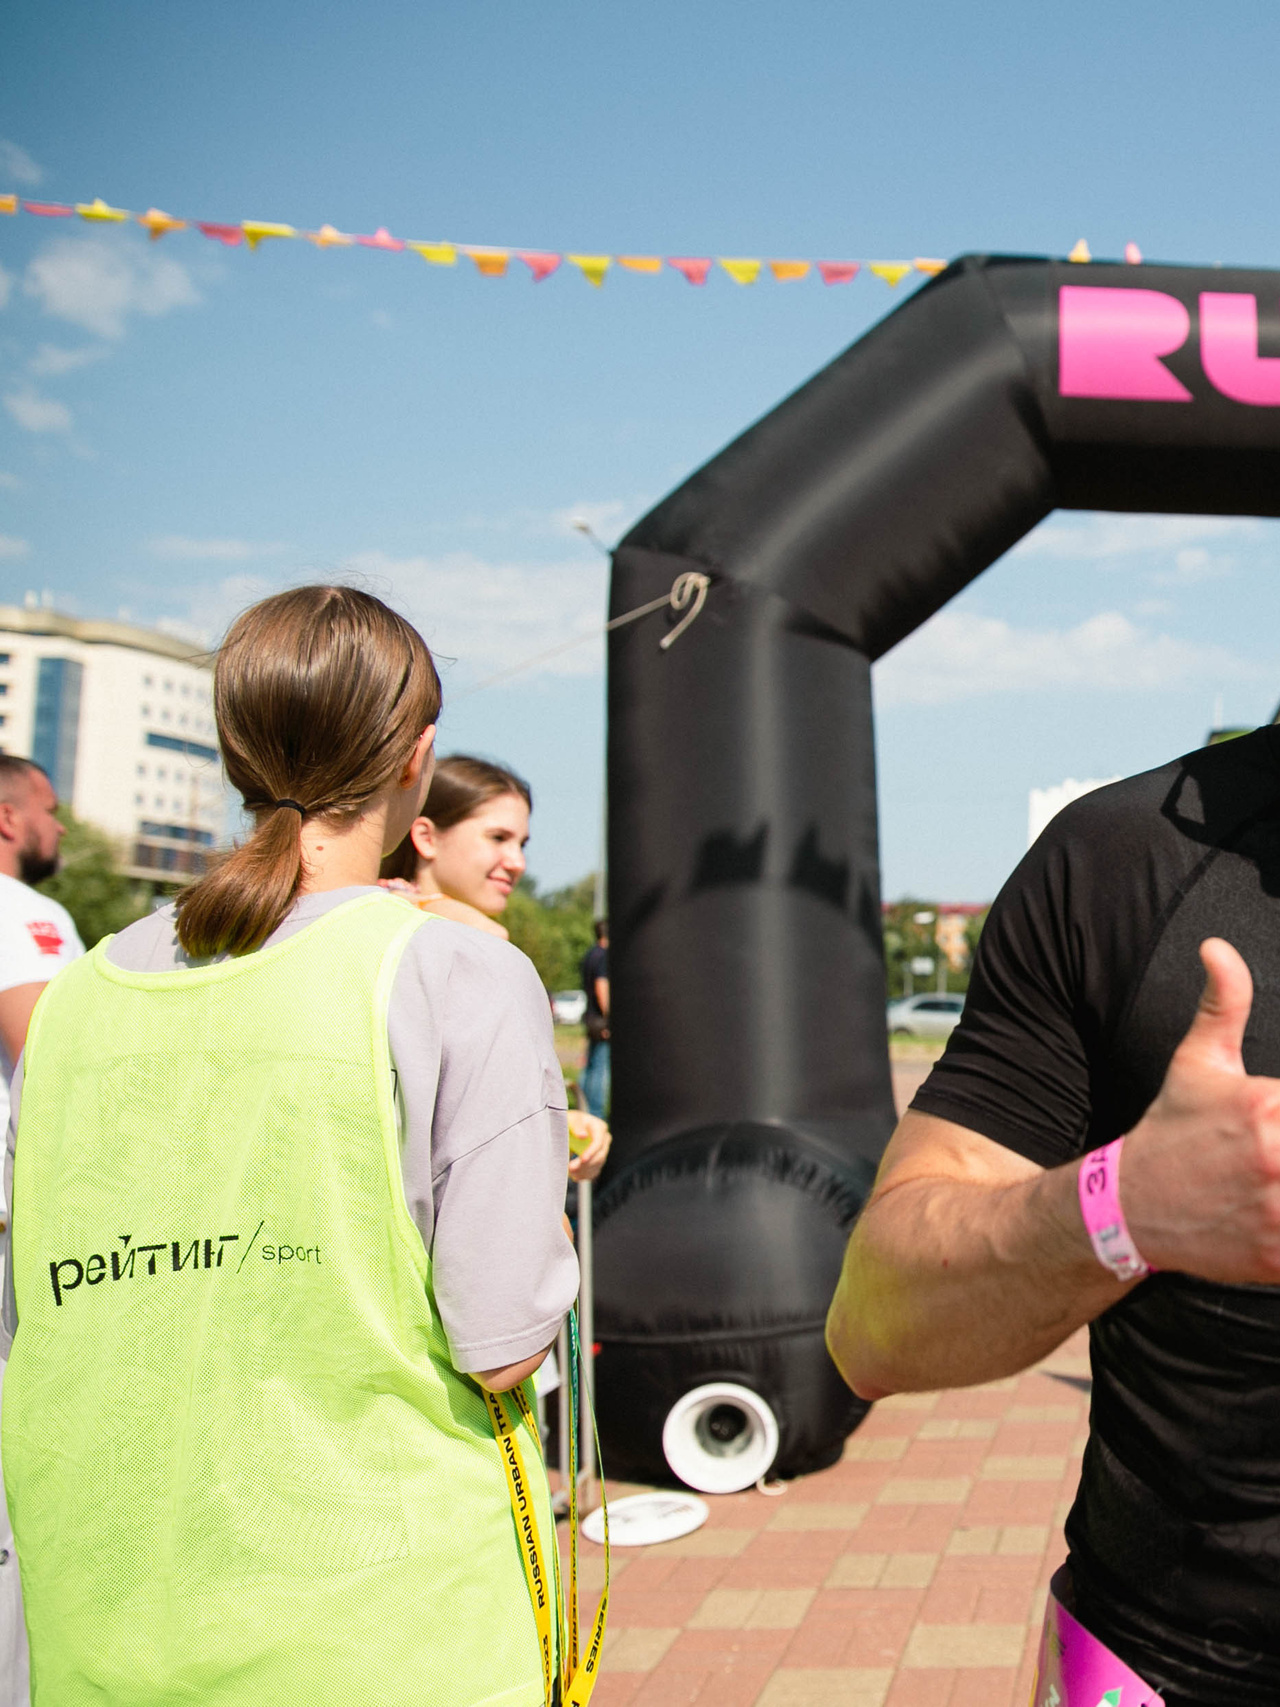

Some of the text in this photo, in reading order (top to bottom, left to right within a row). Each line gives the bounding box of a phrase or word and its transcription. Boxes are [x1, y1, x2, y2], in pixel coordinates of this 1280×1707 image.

[261, 1244, 322, 1265] sport
[488, 1392, 507, 1436] TRA
[502, 1436, 527, 1512] URBAN
[521, 1515, 546, 1610] RUSSIAN
